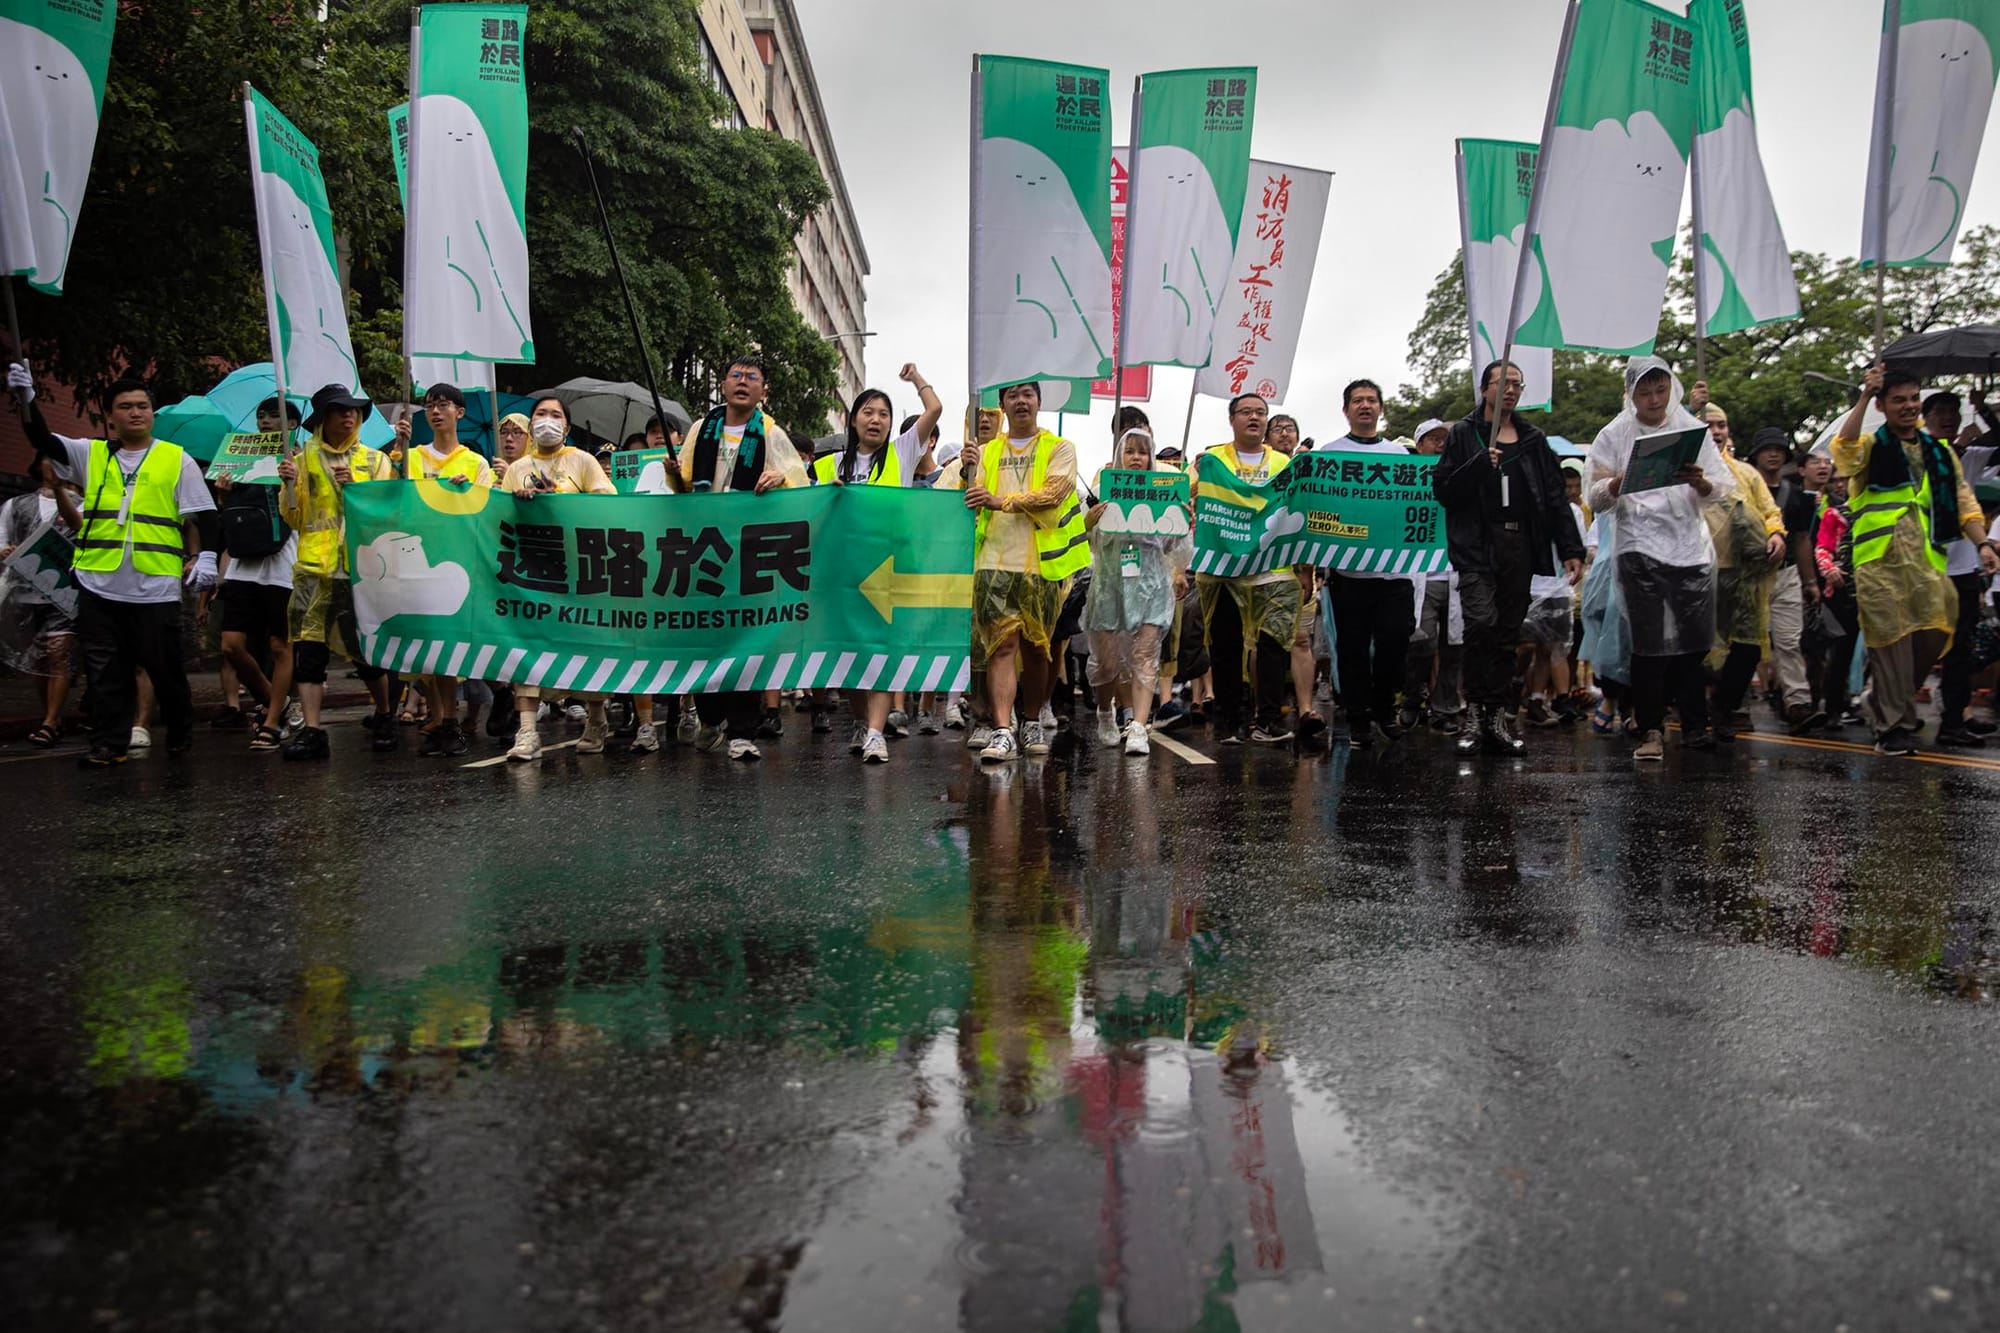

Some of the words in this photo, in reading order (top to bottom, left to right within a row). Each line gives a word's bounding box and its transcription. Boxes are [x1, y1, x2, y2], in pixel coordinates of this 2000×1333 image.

[480, 42, 520, 68] 於民
[1646, 39, 1691, 72] 於民
[1055, 95, 1101, 120] 於民
[1204, 98, 1245, 118] 於民
[1110, 472, 1147, 485] 下了車
[1110, 487, 1182, 502] 你我都是行人
[1301, 482, 1349, 498] KILLING
[1352, 488, 1434, 502] PEDESTRIAN
[1204, 501, 1233, 517] MARCH
[1233, 509, 1252, 520] FOR
[1308, 510, 1340, 522] VISION
[1405, 505, 1430, 524] 08
[1198, 512, 1251, 531] PEDESTRIAN
[1308, 520, 1332, 531] ZERO
[1428, 506, 1438, 543] TAIWAN
[1219, 528, 1251, 542] RIGHTS
[1404, 525, 1427, 543] 20
[496, 519, 812, 598] 還路於民
[495, 598, 552, 620] STOP
[558, 605, 648, 630] KILLING
[653, 602, 809, 630] PEDESTRIANS
